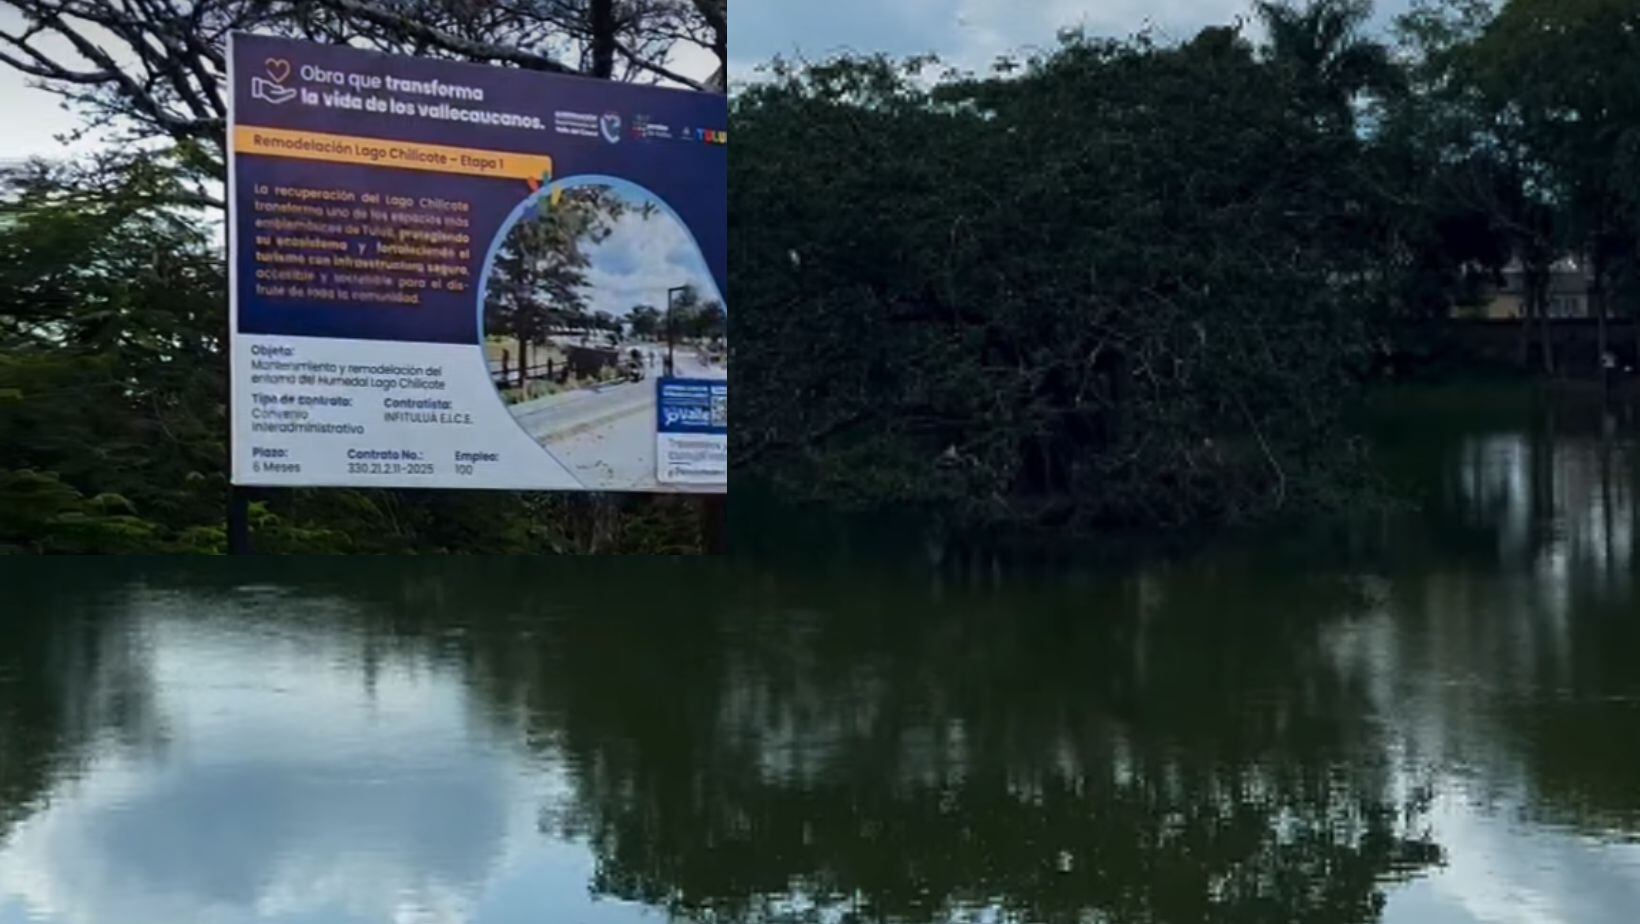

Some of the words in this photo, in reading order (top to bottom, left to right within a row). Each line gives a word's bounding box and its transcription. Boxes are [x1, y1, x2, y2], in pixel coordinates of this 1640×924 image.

[300, 64, 344, 86] Obra
[349, 72, 382, 92] que
[385, 75, 484, 101] transforma
[301, 87, 319, 106] la
[323, 90, 363, 112] vida
[366, 95, 389, 113] de
[389, 95, 415, 116] los
[418, 102, 546, 131] vallecaucanos.
[253, 134, 352, 156] Remodelación
[355, 144, 387, 161] Lago
[389, 147, 447, 165] Chilicote
[460, 154, 497, 171] Etapa
[499, 159, 504, 169] 1
[254, 183, 268, 195] La
[275, 186, 355, 202] recuperación
[361, 191, 380, 204] del
[386, 193, 413, 208] Lago
[327, 206, 350, 219] uno
[353, 206, 368, 220] de
[370, 208, 388, 221] los
[255, 235, 270, 246] su
[358, 242, 366, 255] y
[459, 248, 469, 260] el
[431, 275, 441, 289] el
[251, 345, 294, 357] Objeto:
[339, 365, 345, 375] y
[348, 363, 422, 376] remodelación
[425, 364, 442, 377] del
[299, 373, 315, 386] del
[370, 376, 397, 390] Lago
[399, 376, 445, 390] Chilicote
[384, 397, 452, 410] Contratista:
[252, 447, 288, 458] Plazo:
[347, 449, 399, 460] Contrato
[455, 451, 499, 463] Empleo:
[252, 462, 260, 473] 6
[263, 462, 301, 473] Meses
[455, 464, 473, 475] 100
